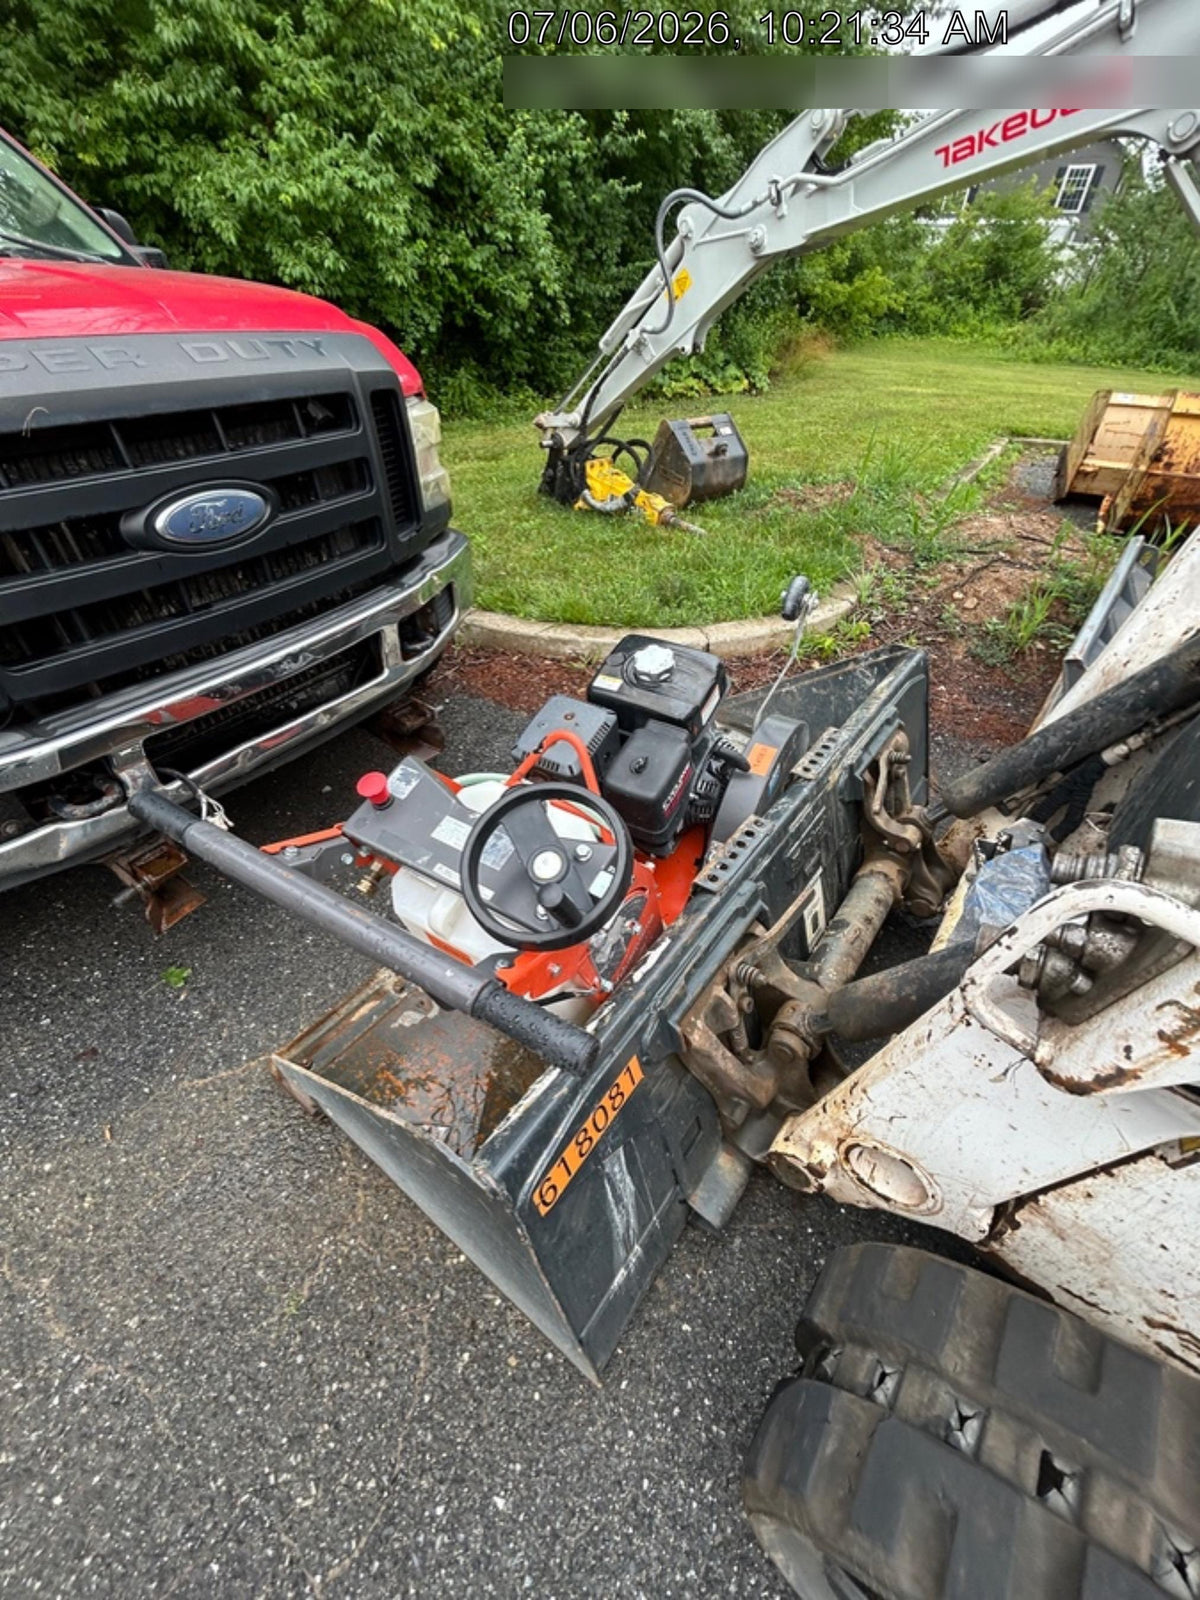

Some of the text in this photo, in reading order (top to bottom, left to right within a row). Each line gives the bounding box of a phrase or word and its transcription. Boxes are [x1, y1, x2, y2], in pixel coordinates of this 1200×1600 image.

[177, 337, 328, 364] DUTY
[190, 499, 244, 533] Ford
[538, 1065, 636, 1207] 618081
